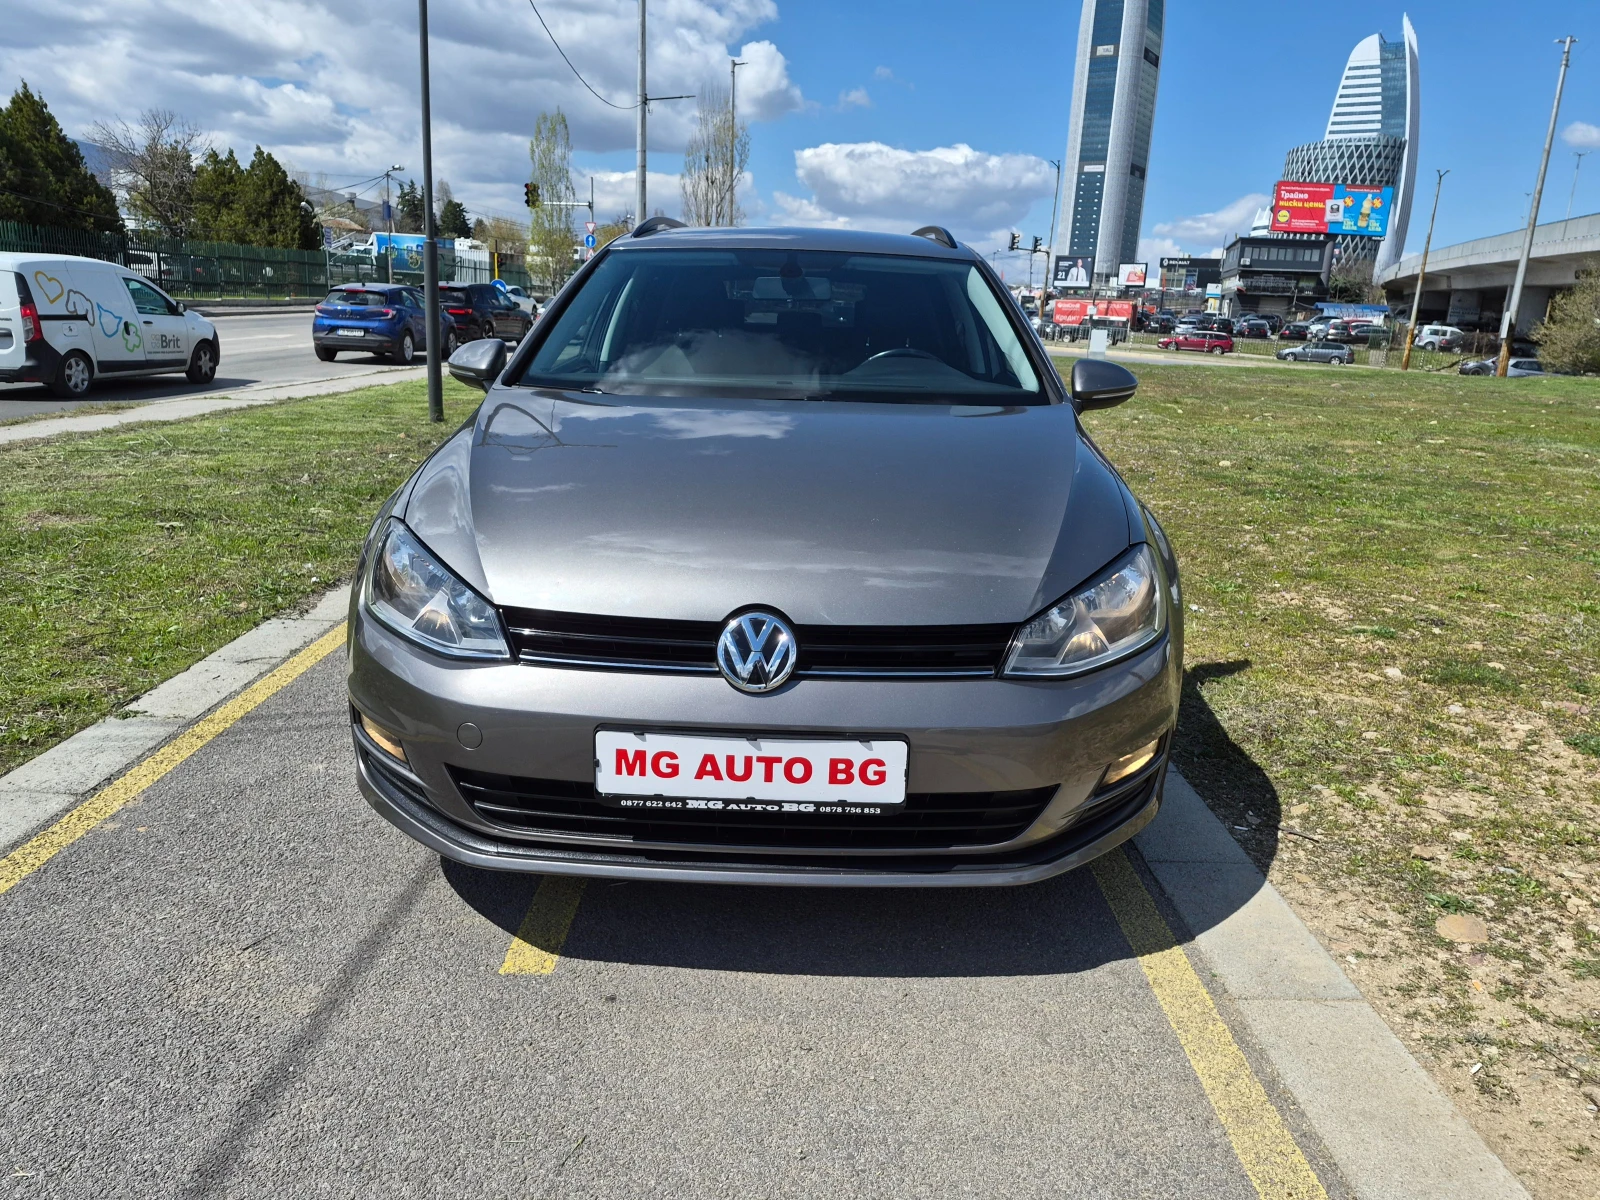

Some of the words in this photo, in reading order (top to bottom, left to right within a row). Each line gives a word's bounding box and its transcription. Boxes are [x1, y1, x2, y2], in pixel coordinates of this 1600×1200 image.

[1280, 190, 1309, 200] Трайно
[1279, 199, 1303, 207] ниски
[1056, 271, 1066, 279] 21
[1055, 314, 1080, 322] Кредит
[160, 334, 181, 349] Brit
[615, 748, 680, 779] MG
[694, 753, 813, 784] AUTO
[828, 757, 887, 786] BG
[620, 799, 644, 808] 0877
[645, 800, 663, 808] 622
[664, 800, 683, 808] 642
[686, 799, 725, 810] MG
[726, 803, 780, 812] AUTO
[780, 802, 817, 812] BG
[819, 805, 844, 814] 0878
[844, 806, 862, 815] 756
[863, 806, 881, 815] 853
